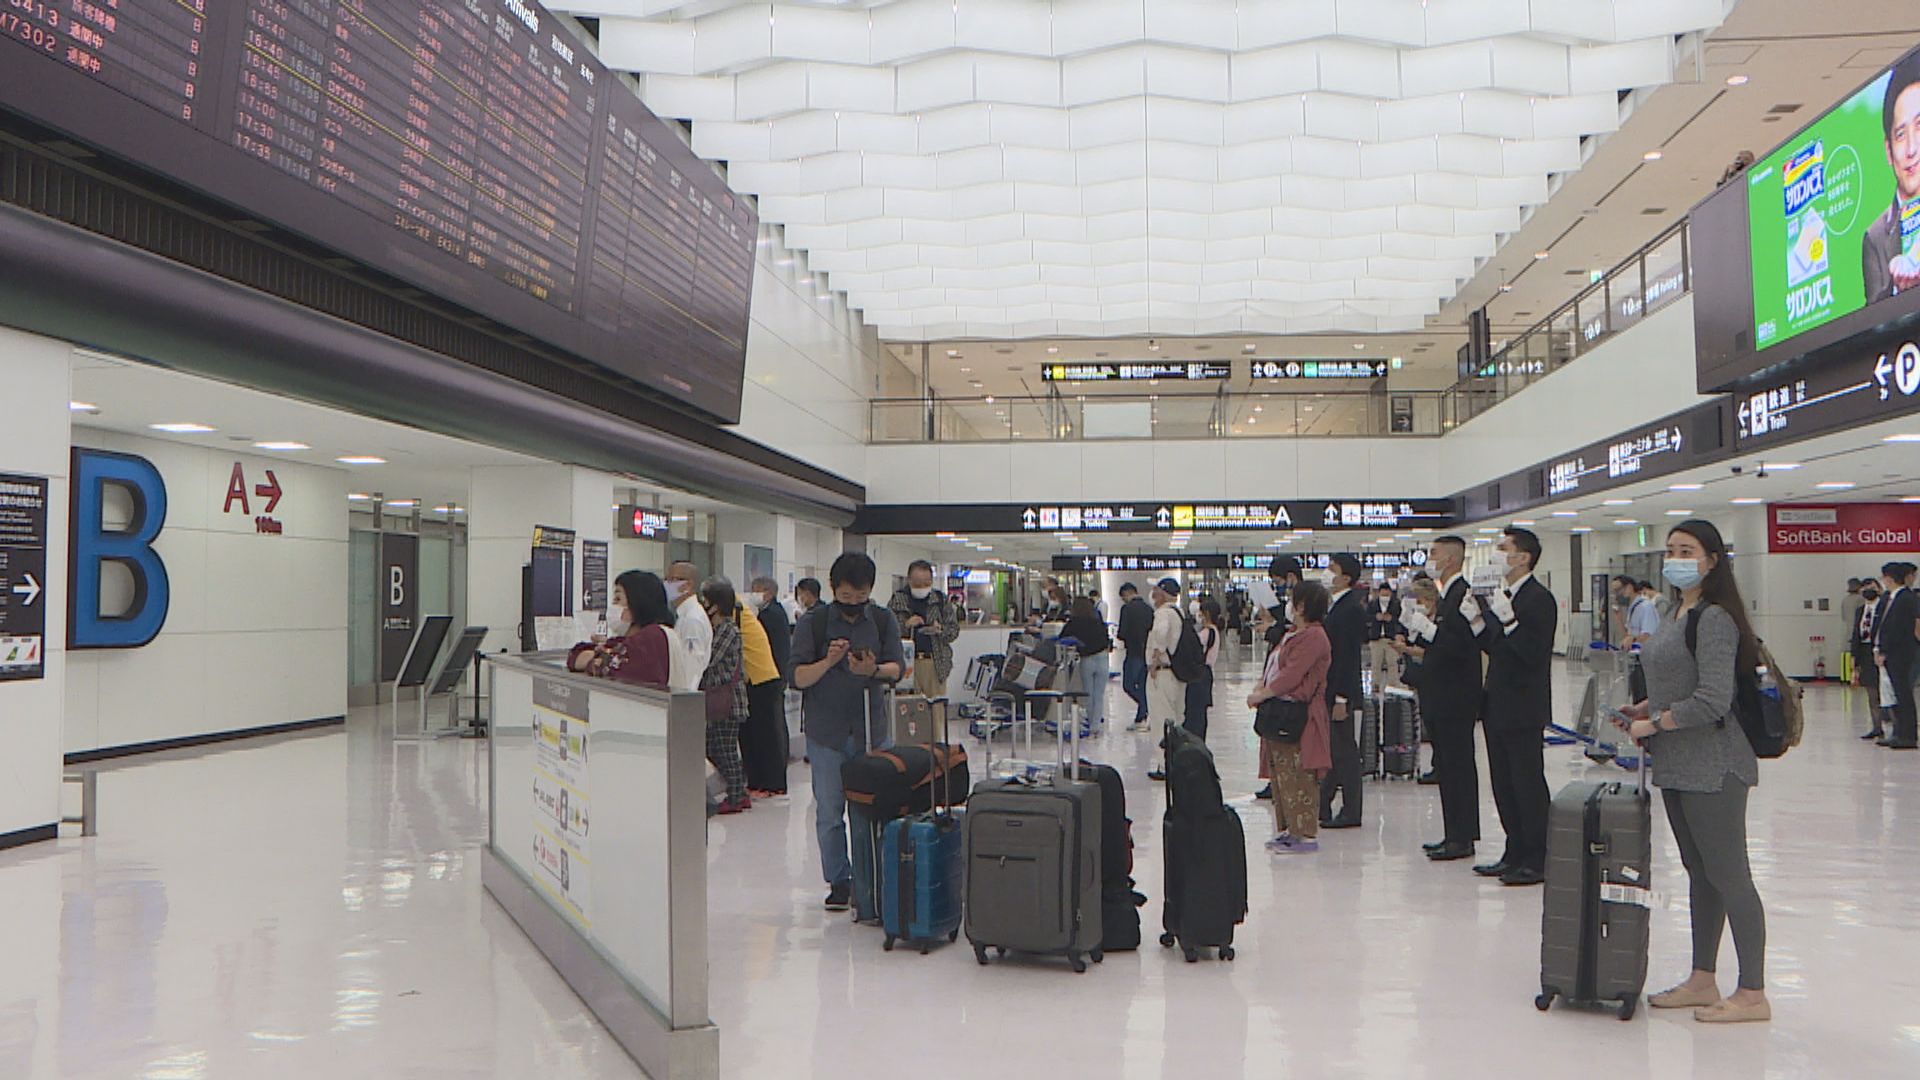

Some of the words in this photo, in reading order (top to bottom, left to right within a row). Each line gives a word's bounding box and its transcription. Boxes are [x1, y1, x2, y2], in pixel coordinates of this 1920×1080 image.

[1786, 164, 1823, 212] サロンパス
[1786, 275, 1834, 322] サロンパス
[1770, 414, 1787, 431] Train
[223, 462, 250, 515] A
[1195, 518, 1243, 528] International
[1244, 518, 1272, 528] Arrivals
[1273, 505, 1292, 526] A
[1363, 516, 1397, 527] Domestic
[1776, 529, 1852, 546] SoftBank
[1857, 528, 1912, 545] Global
[66, 446, 170, 650] B
[1143, 557, 1164, 569] Train
[390, 565, 404, 606] B
